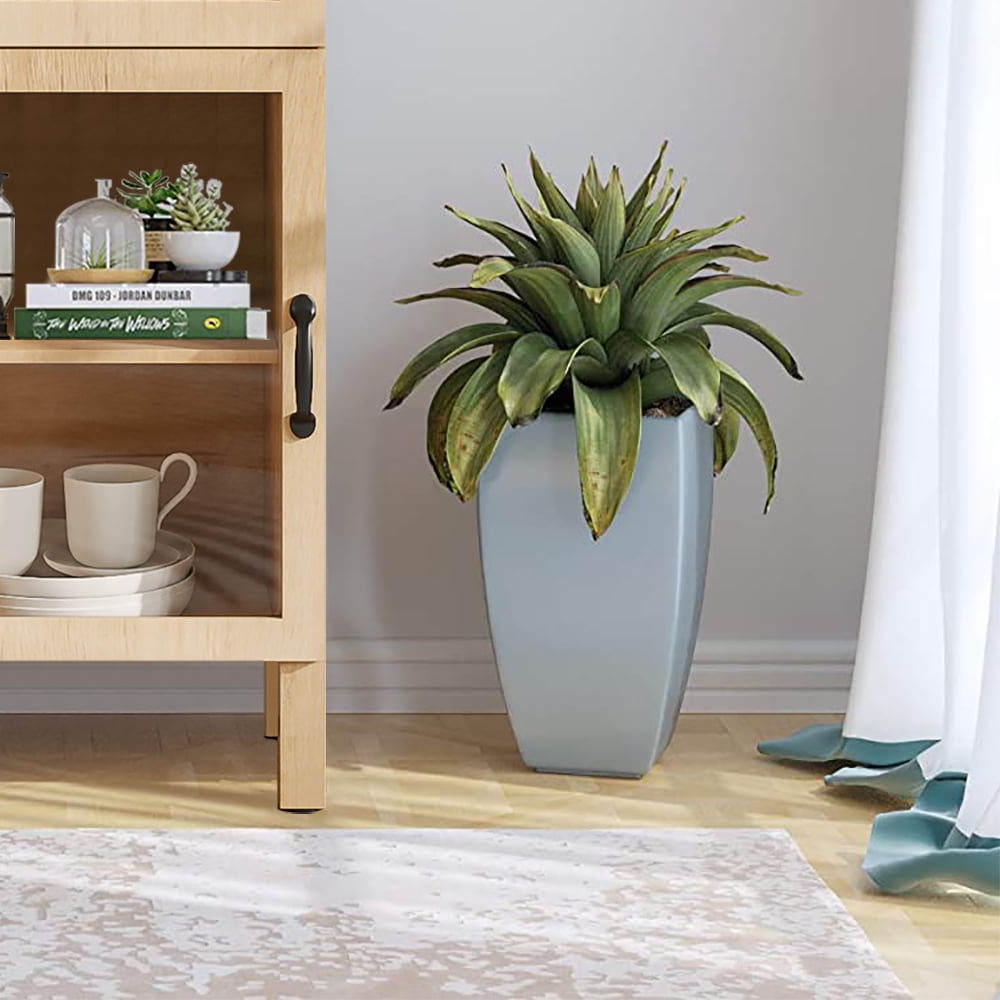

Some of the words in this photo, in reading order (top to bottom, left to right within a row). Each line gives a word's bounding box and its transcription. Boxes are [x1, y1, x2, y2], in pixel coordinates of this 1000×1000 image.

[95, 290, 111, 301] 109
[118, 290, 152, 301] JORDAN
[154, 290, 192, 301] DUNBAR
